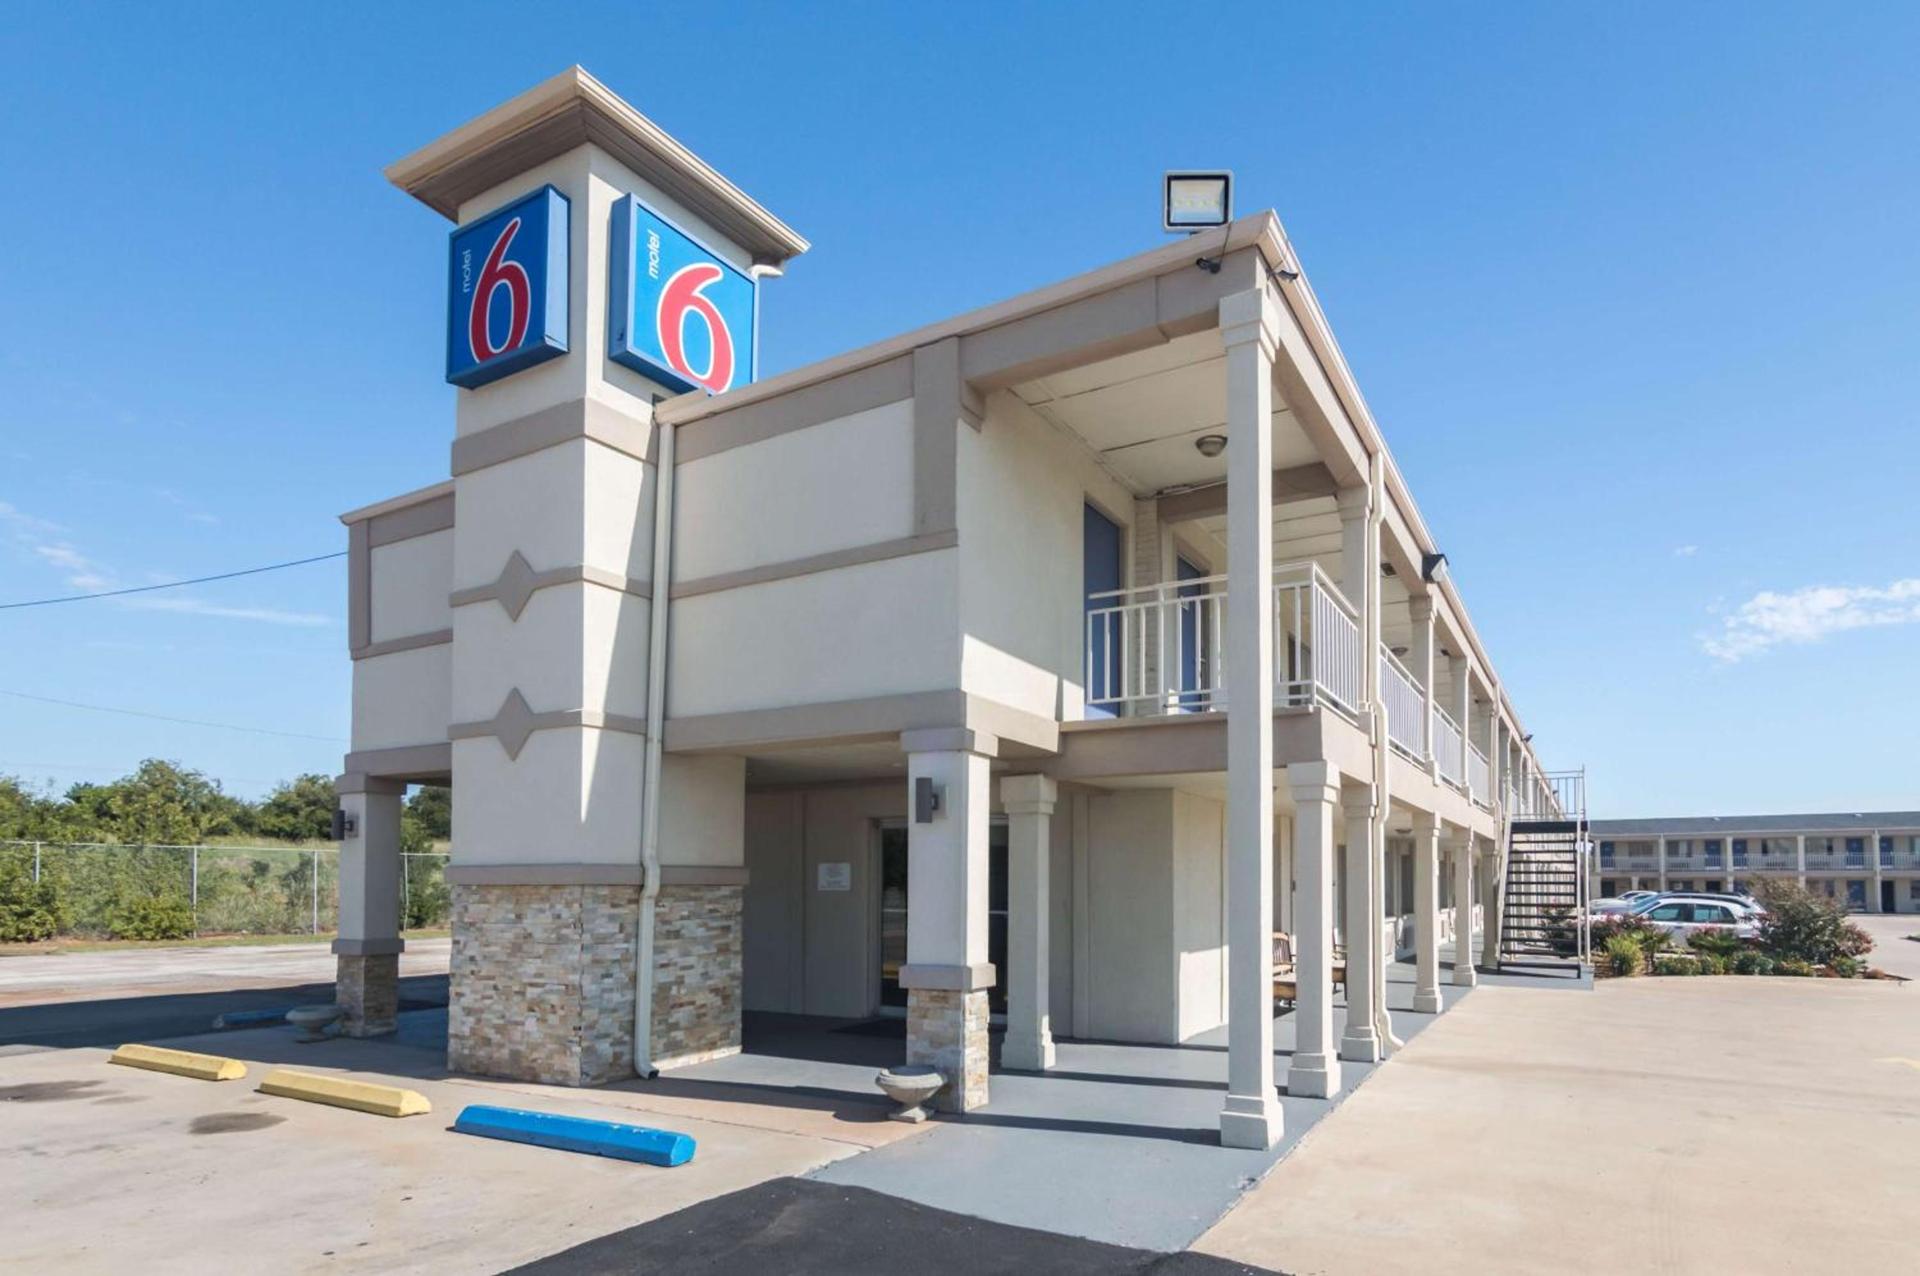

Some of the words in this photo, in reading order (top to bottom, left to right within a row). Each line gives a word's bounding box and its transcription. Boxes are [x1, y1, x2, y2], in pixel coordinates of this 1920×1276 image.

[463, 249, 472, 293] motel
[469, 217, 531, 363] 6
[648, 229, 661, 279] motel
[656, 262, 735, 394] 6
